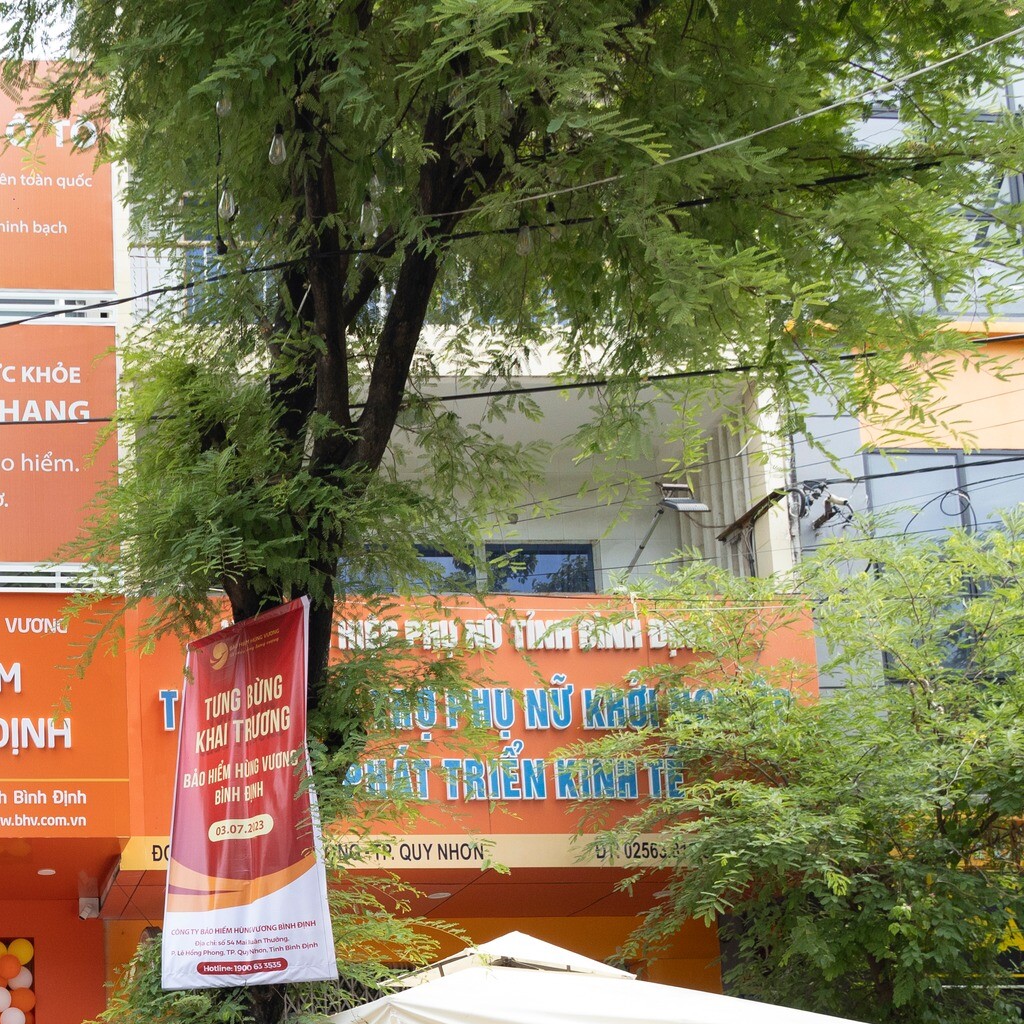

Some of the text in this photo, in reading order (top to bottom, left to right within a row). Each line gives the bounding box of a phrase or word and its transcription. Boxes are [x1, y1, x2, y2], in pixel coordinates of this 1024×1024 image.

[6, 113, 32, 147] Ô
[19, 170, 53, 186] toàn
[57, 171, 93, 190] quốc
[33, 219, 68, 237] bạch
[22, 362, 81, 384] KHỎE
[21, 451, 80, 473] hiểm.
[5, 615, 69, 635] VƯƠNG
[204, 687, 241, 721] TƯNG
[247, 674, 283, 710] BỪNG
[523, 674, 574, 731] NỮ
[195, 705, 291, 754] KHAI TRƯƠNG
[183, 766, 206, 789] BẢO
[207, 759, 231, 785] HIỂM
[235, 757, 259, 779] HÙNG
[441, 740, 547, 801] TRIỂN
[555, 757, 640, 801] KINH
[13, 788, 47, 805] Bình
[52, 790, 87, 807] Định
[215, 781, 264, 806] BÌNH ĐỊNH
[399, 843, 433, 861] QUY
[171, 926, 190, 936] CÔNG
[191, 927, 199, 935] TY
[215, 924, 233, 934] HIỂM
[278, 921, 296, 931] BÌNH
[297, 920, 317, 930] ĐỊNH
[203, 961, 282, 973] Hotline: 1900 63 3535
